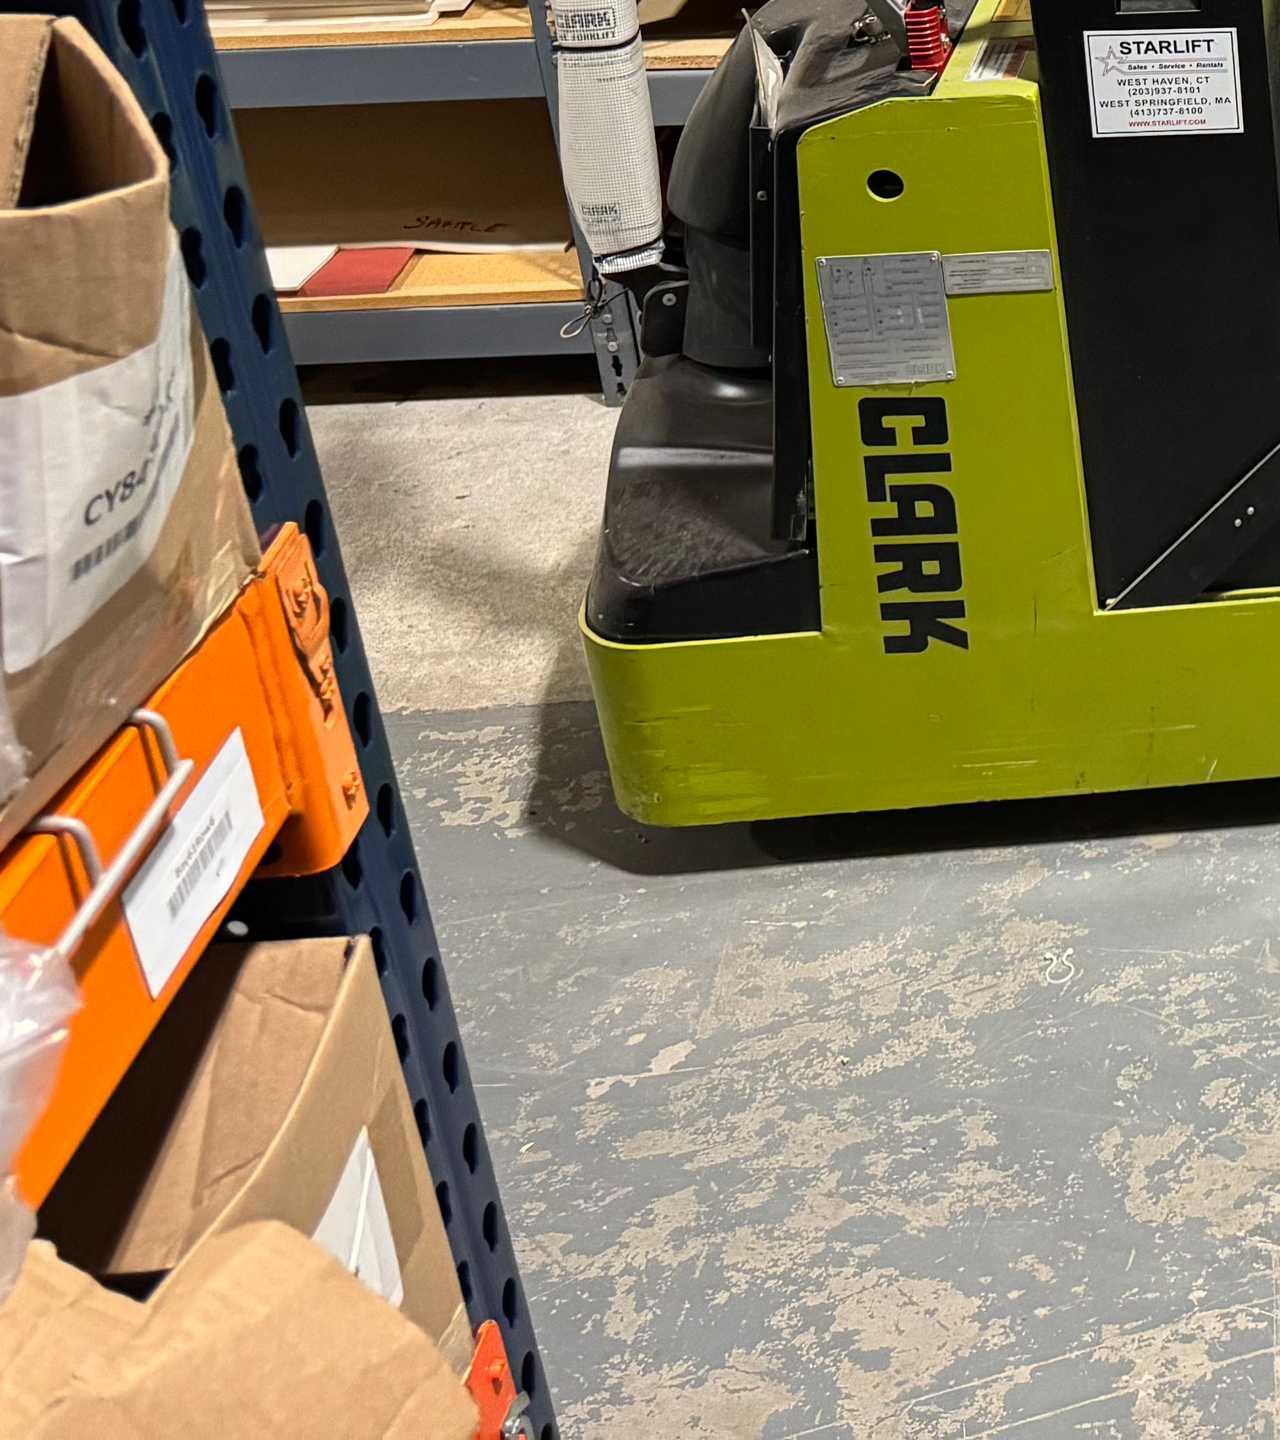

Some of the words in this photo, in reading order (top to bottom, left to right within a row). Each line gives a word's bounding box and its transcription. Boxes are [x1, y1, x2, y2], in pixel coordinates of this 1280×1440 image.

[1120, 39, 1215, 55] STARLIFT
[1158, 62, 1186, 70] Service
[1196, 61, 1224, 69] Rentals
[1117, 78, 1148, 87] WEST
[1152, 76, 1193, 86] HAVEN,
[1196, 75, 1211, 84] CT
[1128, 86, 1201, 98] (203)937-8101
[1099, 99, 1131, 109] WEST
[1134, 97, 1212, 107] SPRINGFIELD,
[1215, 96, 1232, 105] MA
[1130, 106, 1204, 118] (413)737-8100
[1128, 118, 1207, 128] WWW.STARLIFT.COM
[857, 396, 970, 655] CLARK
